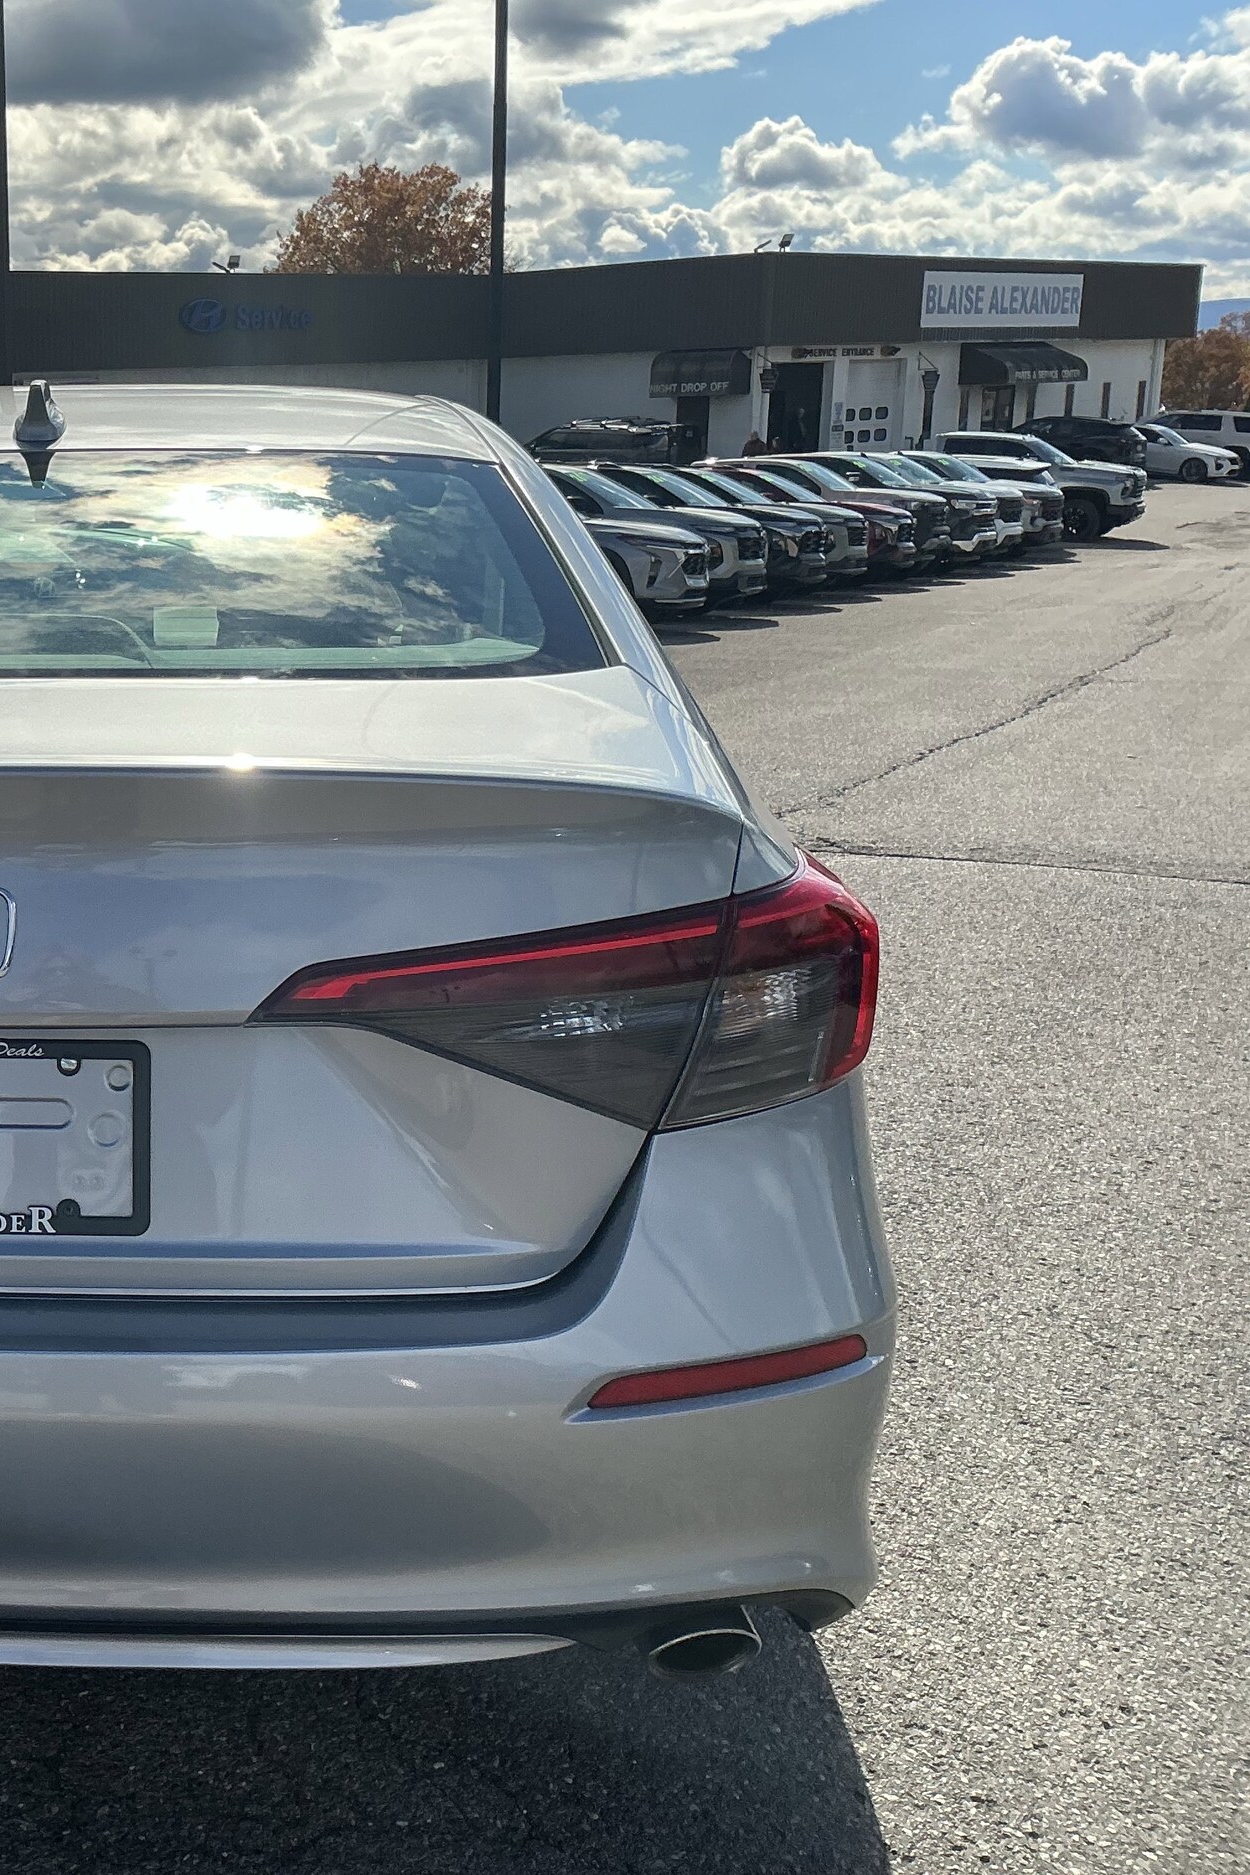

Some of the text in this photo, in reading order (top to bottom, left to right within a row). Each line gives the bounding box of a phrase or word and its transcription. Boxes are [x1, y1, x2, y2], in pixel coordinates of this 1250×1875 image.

[925, 284, 1081, 315] BLAISE ALEXANDER
[235, 304, 312, 331] Service
[810, 347, 875, 358] SERVICE ENTRANCE
[1061, 368, 1081, 379] CENTER
[650, 381, 729, 395] NIGHT DROP OFF
